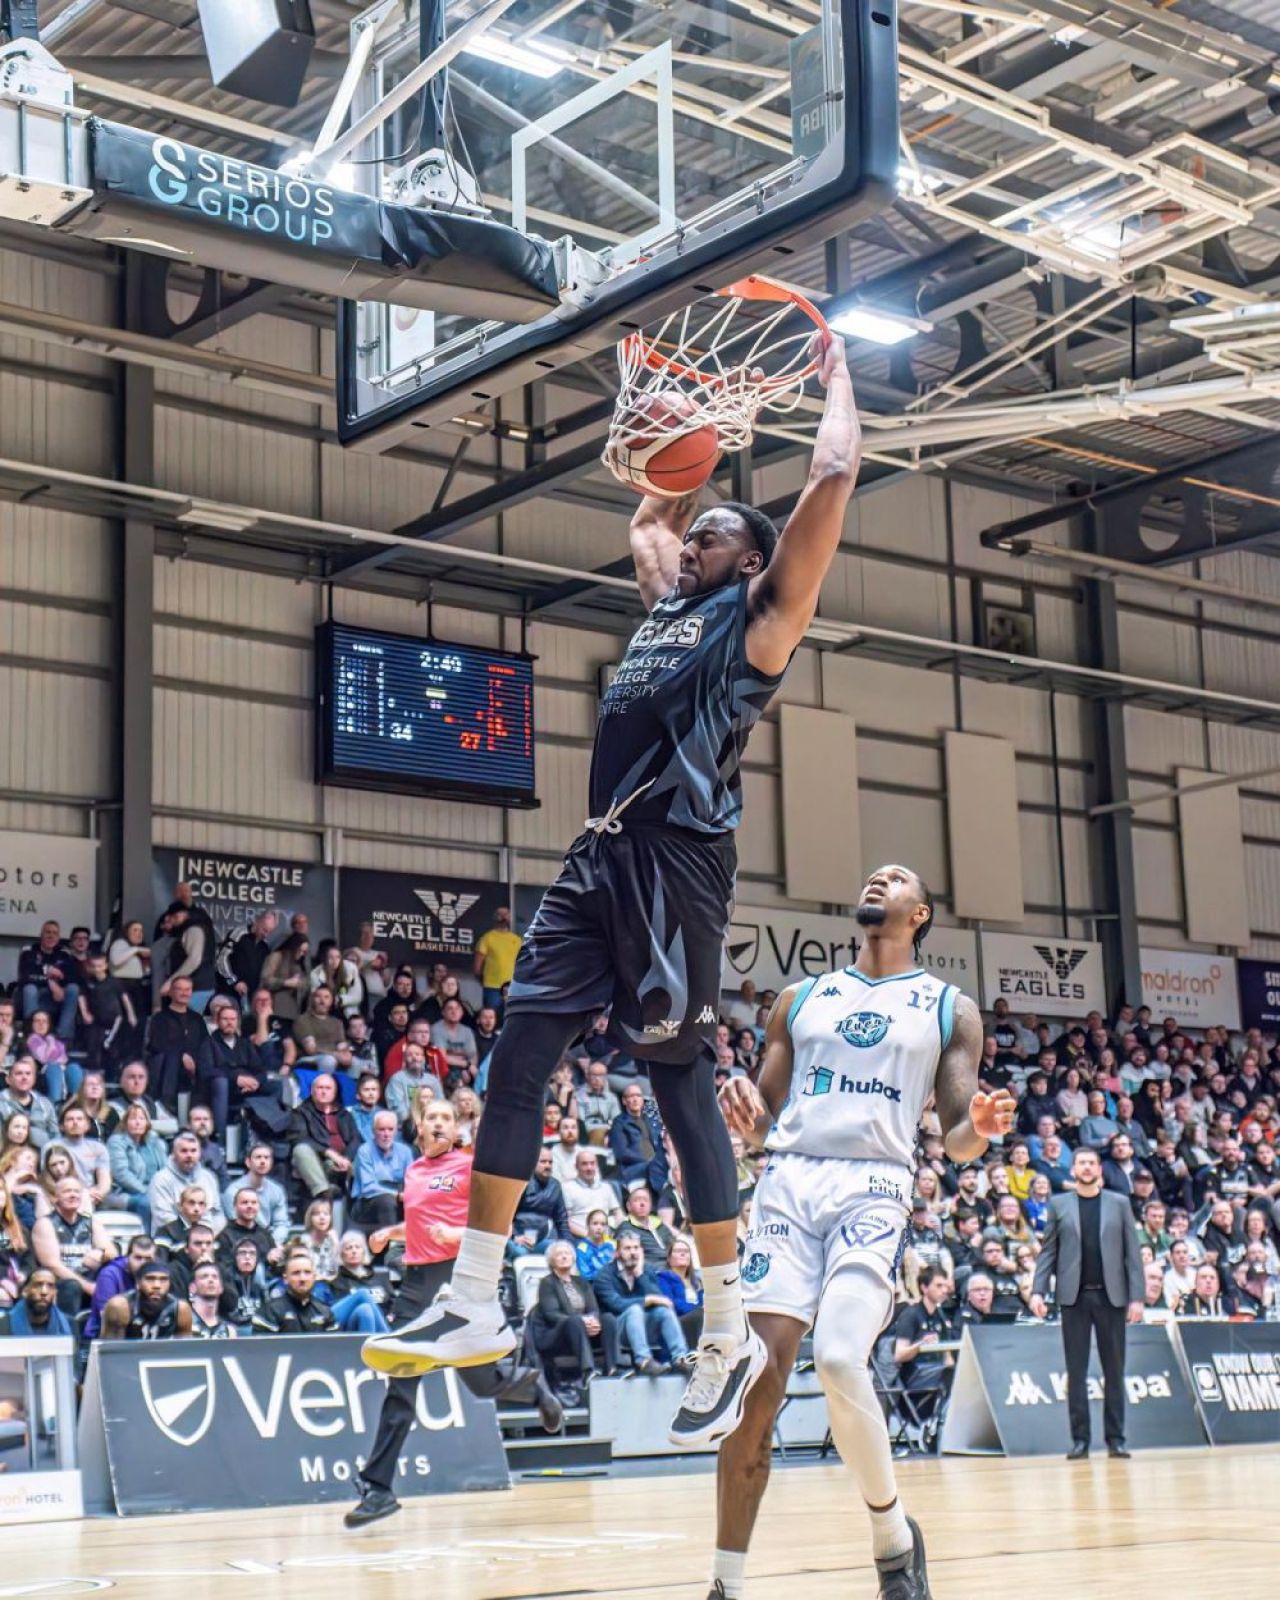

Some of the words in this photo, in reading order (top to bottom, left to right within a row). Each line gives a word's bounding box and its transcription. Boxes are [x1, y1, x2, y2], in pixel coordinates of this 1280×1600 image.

[197, 153, 334, 217] SERIOS
[198, 187, 333, 247] GROUP
[628, 615, 705, 651] GLES
[599, 701, 629, 716] NTRE
[187, 857, 304, 887] NEWCASTLE
[190, 879, 276, 905] COLLEGE
[372, 911, 432, 925] NEWCASTLE
[372, 921, 475, 945] EAGLES
[414, 941, 473, 954] BASKETBALL
[915, 953, 968, 970] otors
[1000, 977, 1086, 1000] EAGLES
[906, 990, 938, 1013] 17
[222, 1353, 467, 1439] Veru
[1049, 1371, 1171, 1403] Kapa
[299, 1453, 432, 1483] Motrs
[25, 1492, 64, 1505] HOTEL
